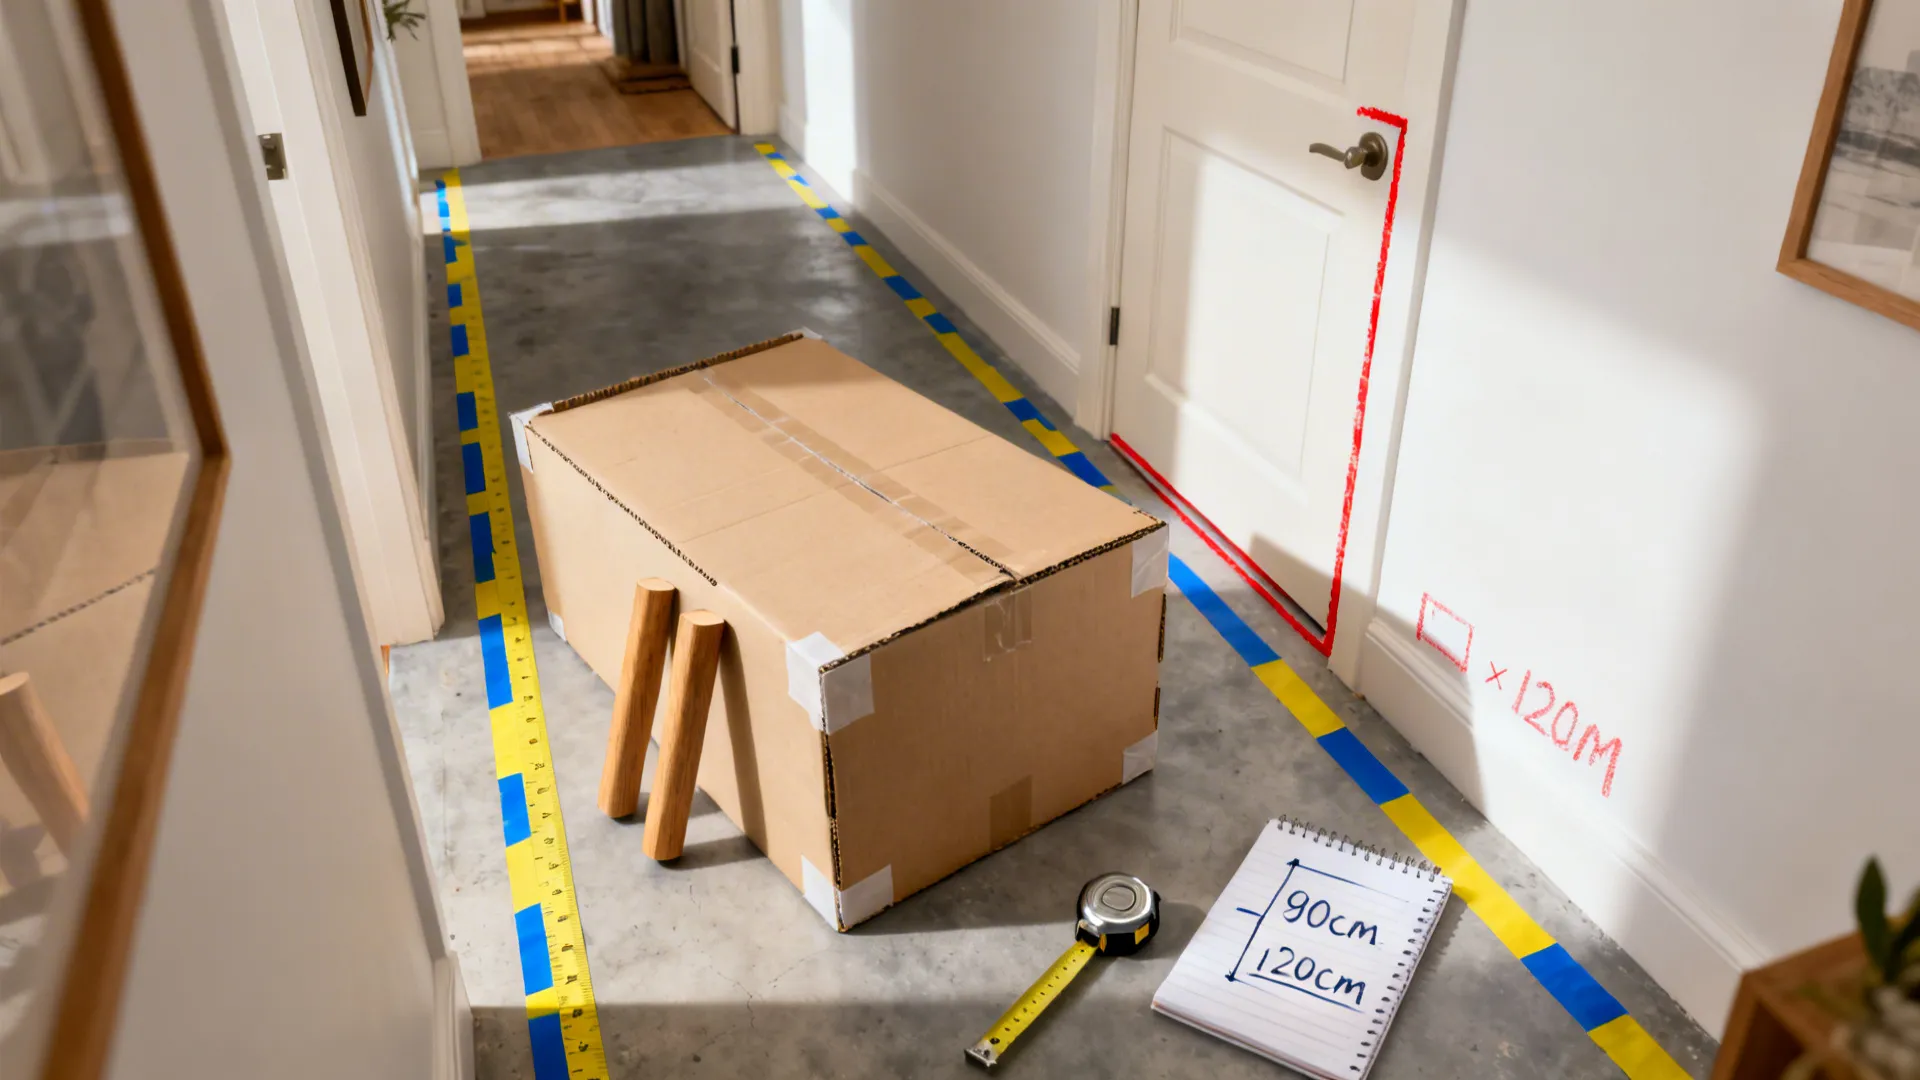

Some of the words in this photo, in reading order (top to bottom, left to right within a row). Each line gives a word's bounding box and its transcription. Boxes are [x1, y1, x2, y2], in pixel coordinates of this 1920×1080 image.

[1512, 669, 1622, 798] 120M
[1282, 890, 1377, 945] 90cm
[1256, 946, 1366, 1005] 120cm
